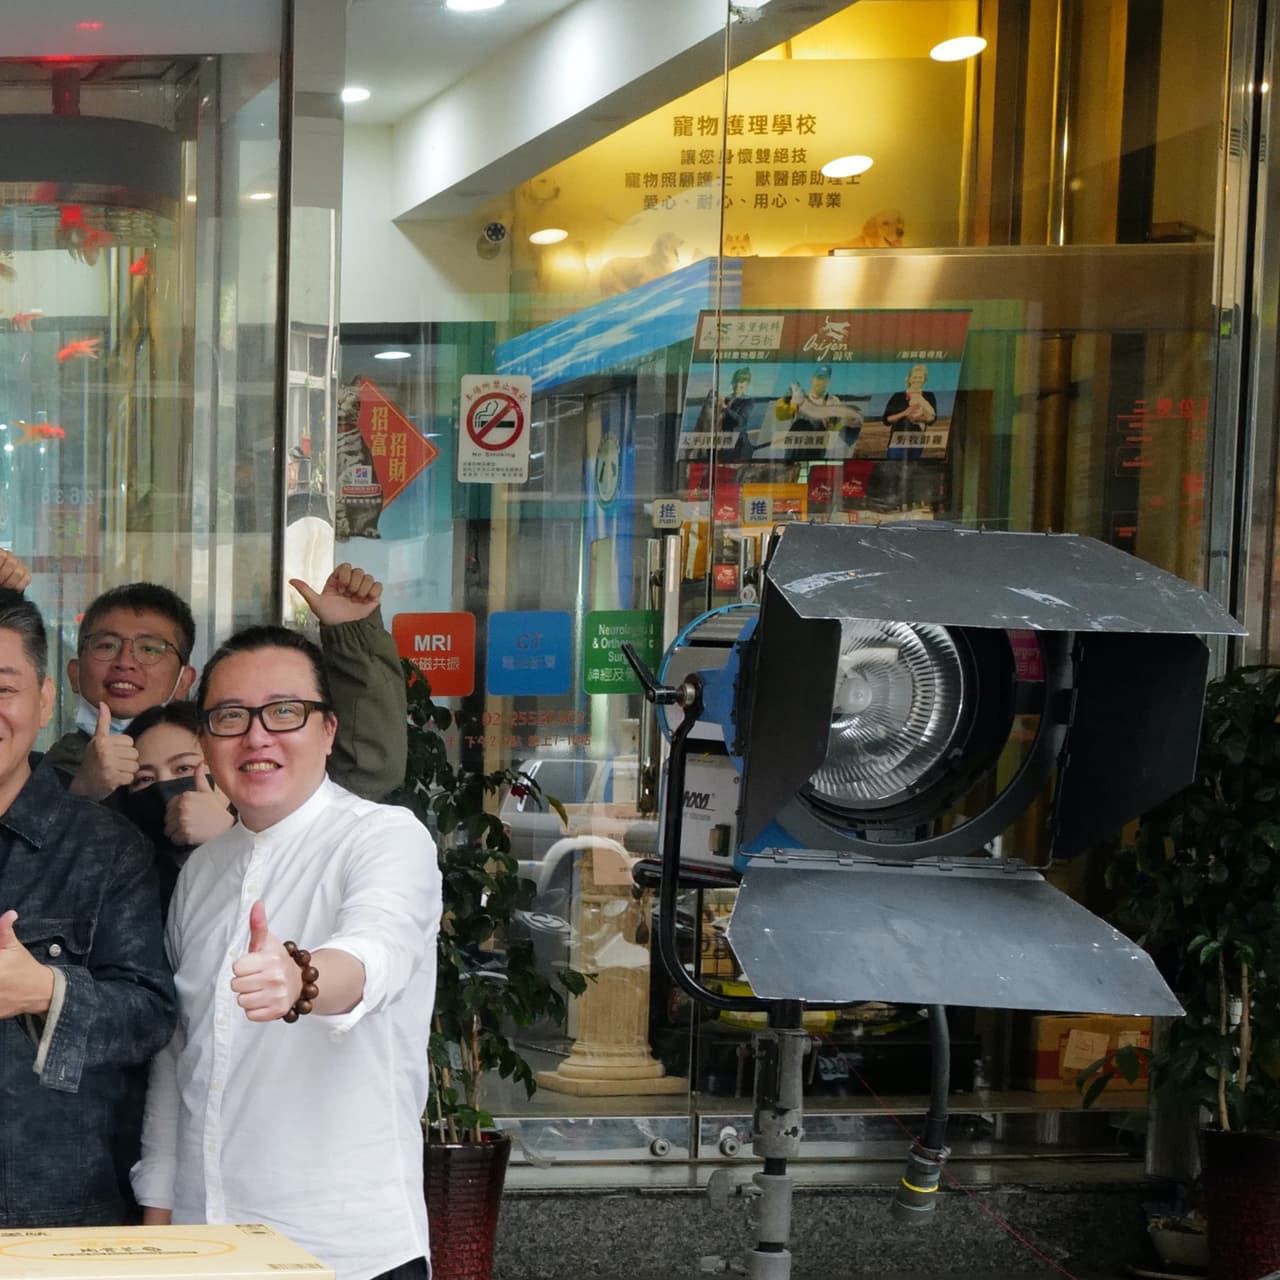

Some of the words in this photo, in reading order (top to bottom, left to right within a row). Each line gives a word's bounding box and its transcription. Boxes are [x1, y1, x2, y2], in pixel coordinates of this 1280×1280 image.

[370, 406, 389, 457] 招富
[388, 433, 407, 482] 招財
[659, 503, 677, 518] 推
[750, 499, 767, 515] 推
[414, 635, 452, 652] MRI
[408, 656, 461, 671] 磁共振
